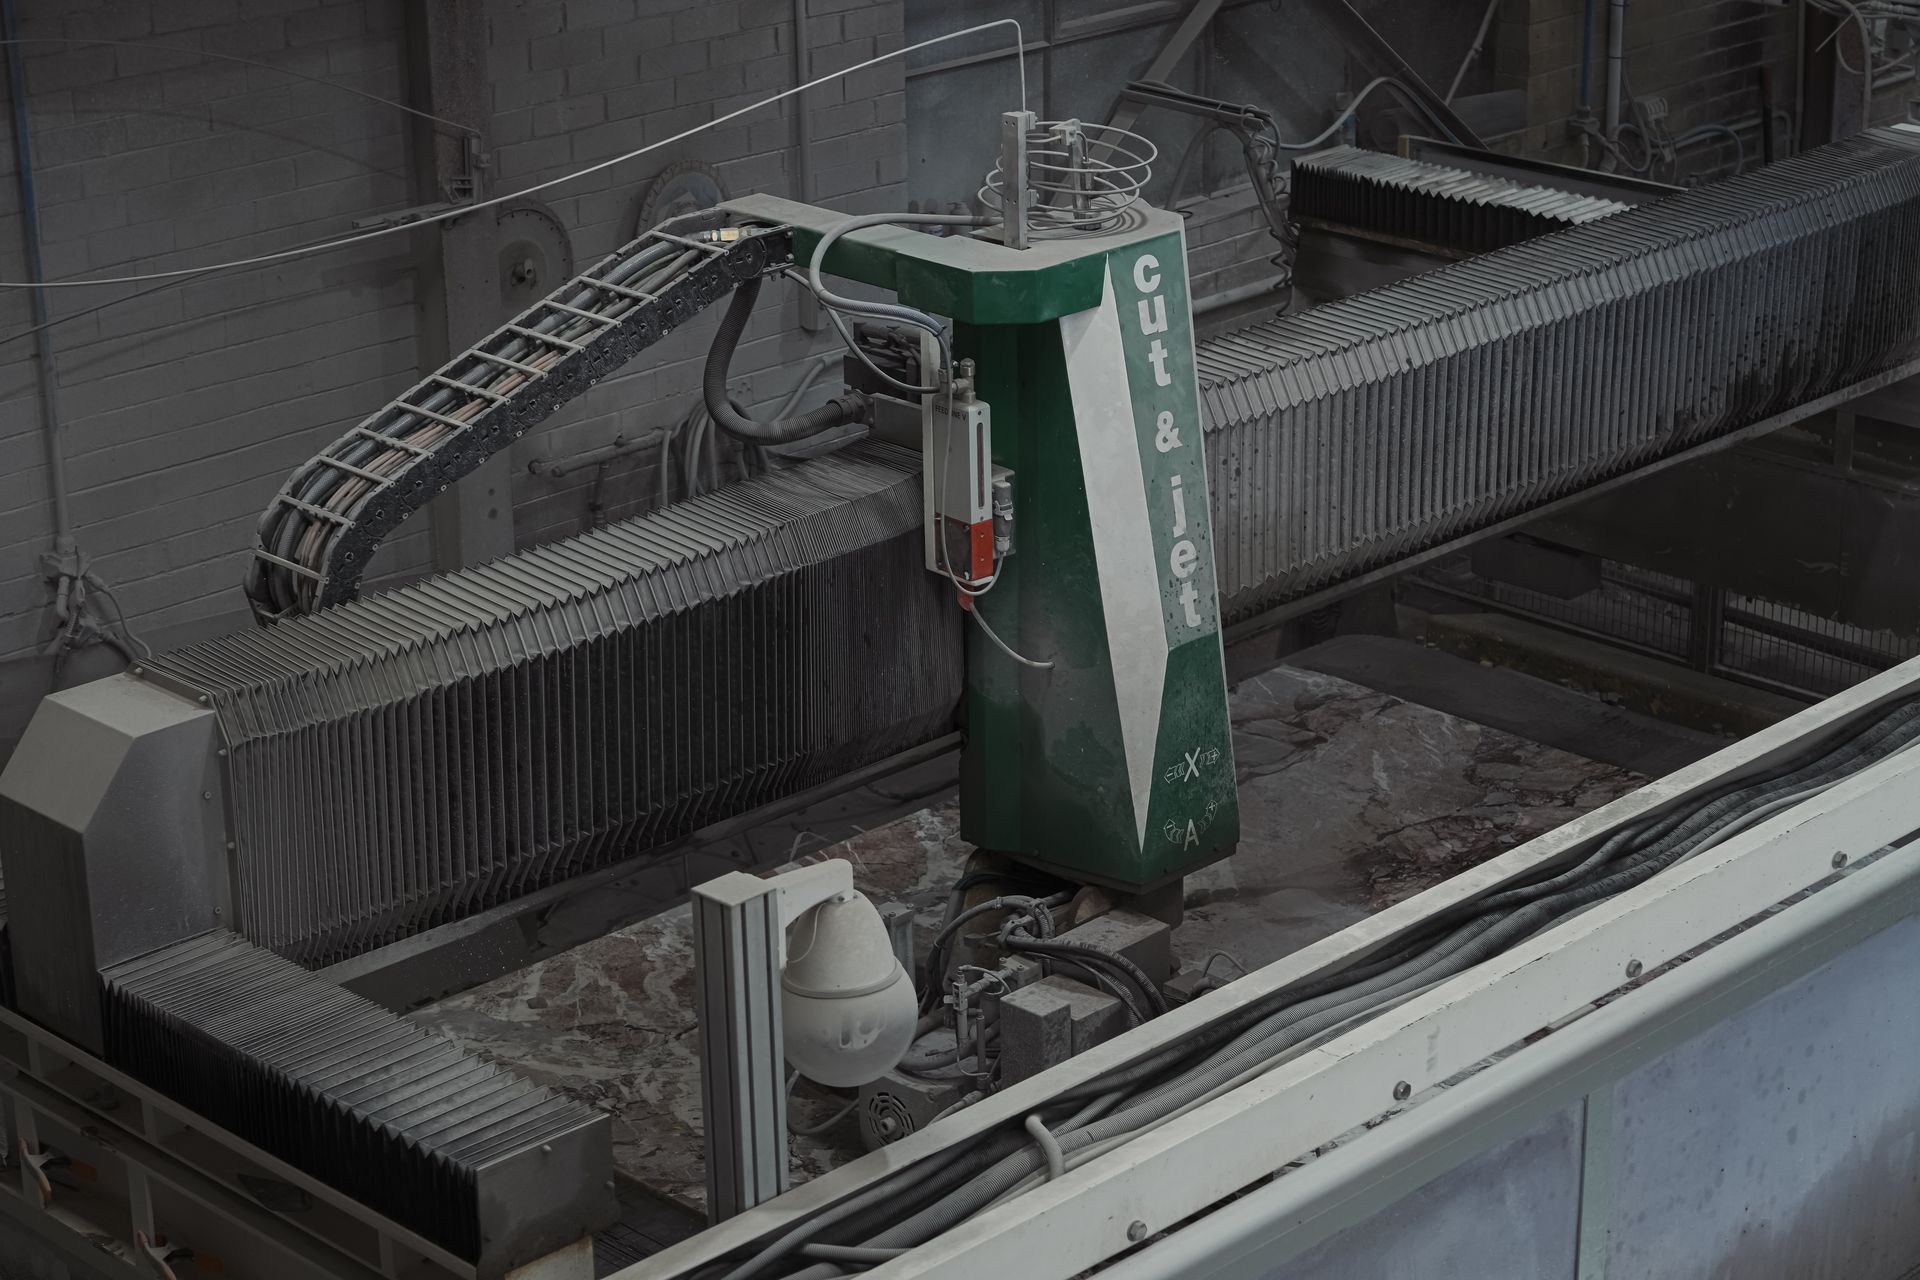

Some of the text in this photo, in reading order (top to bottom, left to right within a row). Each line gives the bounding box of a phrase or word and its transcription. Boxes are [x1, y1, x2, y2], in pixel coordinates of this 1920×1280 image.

[935, 404, 961, 419] FEEDINE
[1133, 254, 1202, 628] cut & jet
[1183, 818, 1200, 852] A
